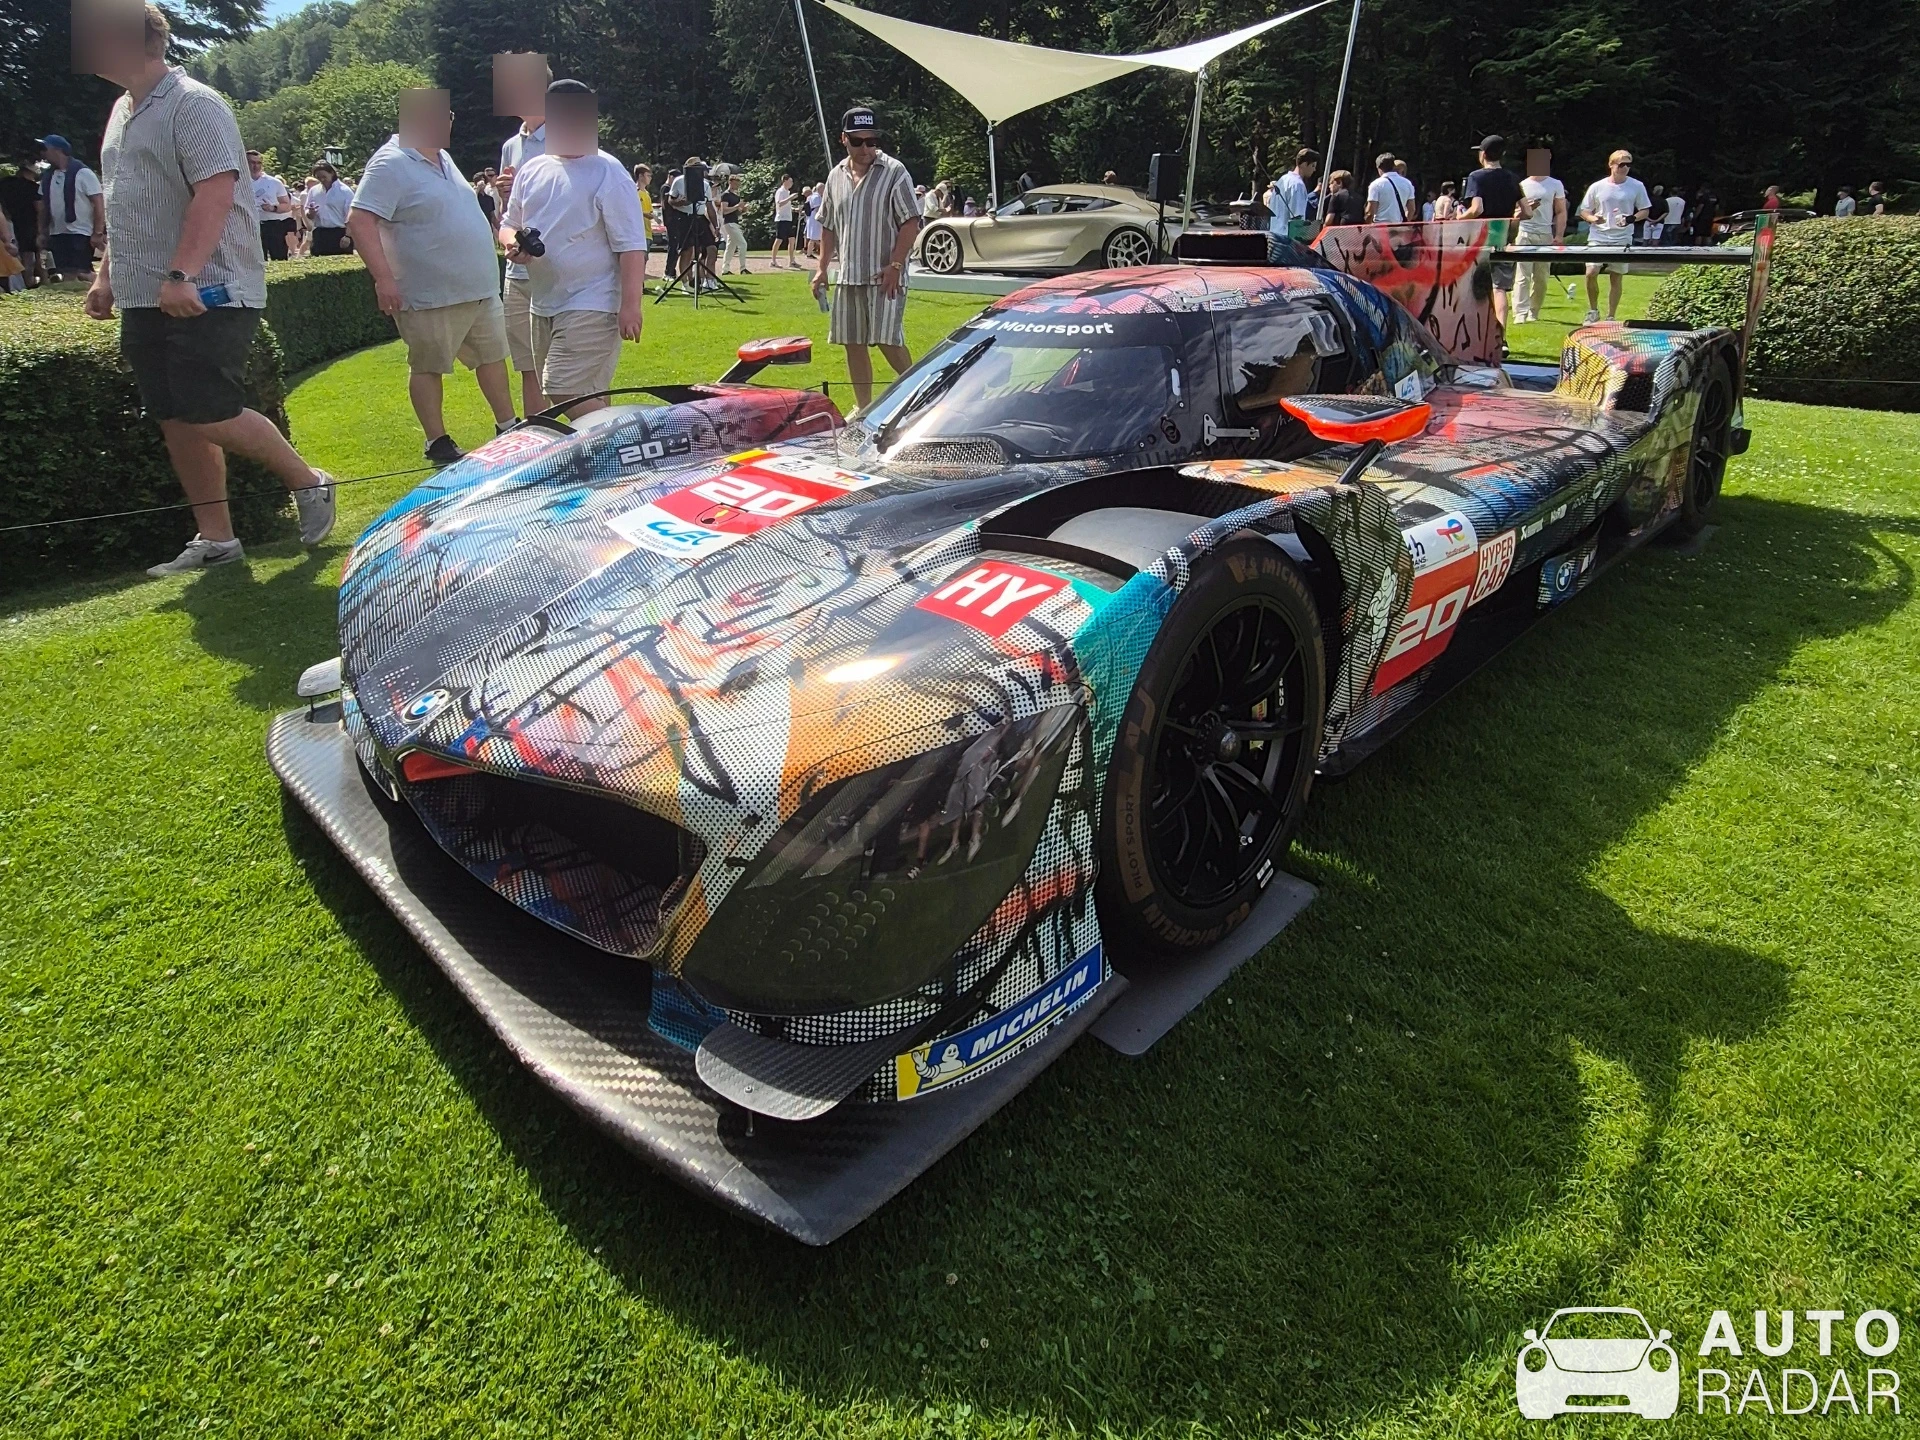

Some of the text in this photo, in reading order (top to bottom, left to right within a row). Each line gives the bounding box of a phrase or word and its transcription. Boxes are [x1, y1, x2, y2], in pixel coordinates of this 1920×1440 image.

[1259, 292, 1278, 302] RAST
[997, 321, 1114, 336] Motorsport
[618, 441, 665, 464] 20
[689, 475, 818, 518] 20
[1481, 536, 1513, 570] HYPER
[933, 568, 1053, 618] HY
[1472, 558, 1510, 601] CAR
[1383, 584, 1471, 663] 20
[1125, 794, 1143, 889] PILOT SPORT
[969, 965, 1089, 1060] MICHELIN
